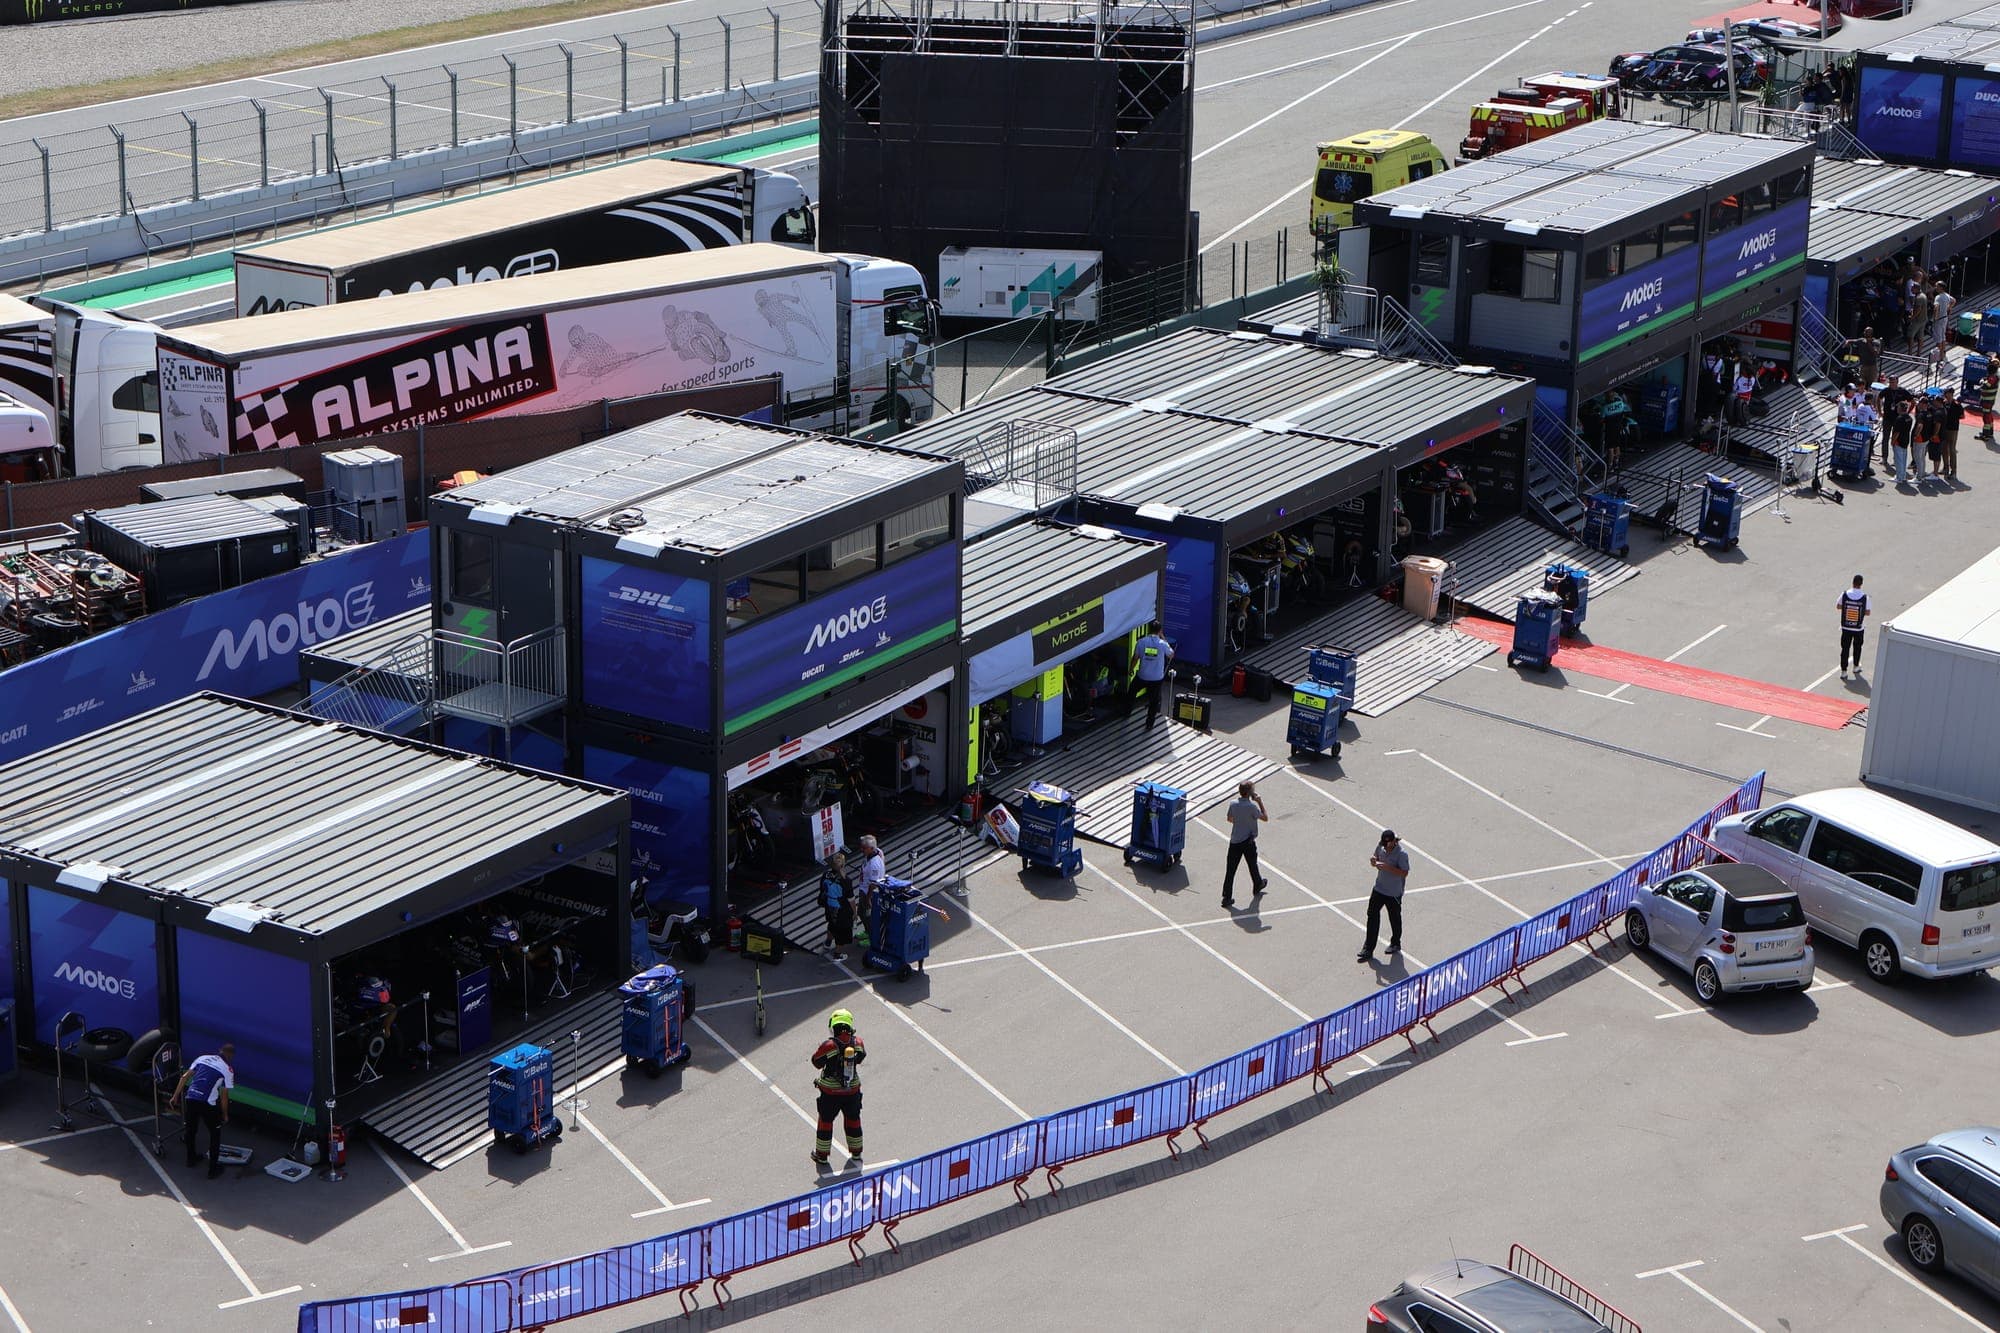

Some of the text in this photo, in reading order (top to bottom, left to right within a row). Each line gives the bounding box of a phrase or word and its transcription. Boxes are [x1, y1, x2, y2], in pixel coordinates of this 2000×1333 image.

[61, 2, 123, 14] ENERGY
[1876, 106, 1922, 119] MotoE
[179, 365, 223, 382] ALPINA
[312, 326, 534, 438] ALPINA
[681, 367, 716, 390] speed
[718, 357, 755, 379] sports
[619, 586, 674, 609] DHL
[196, 581, 376, 682] MotoE
[804, 595, 887, 654] MotoE
[801, 664, 825, 680] DUCATI
[1323, 659, 1339, 669] Beta
[127, 680, 156, 695] MICHELIN
[64, 698, 97, 719] DHL
[0, 724, 28, 744] CATI
[628, 786, 664, 801] DUCATI
[54, 962, 135, 998] MotoE
[663, 989, 679, 1002] Beta
[530, 1062, 548, 1076] Beta
